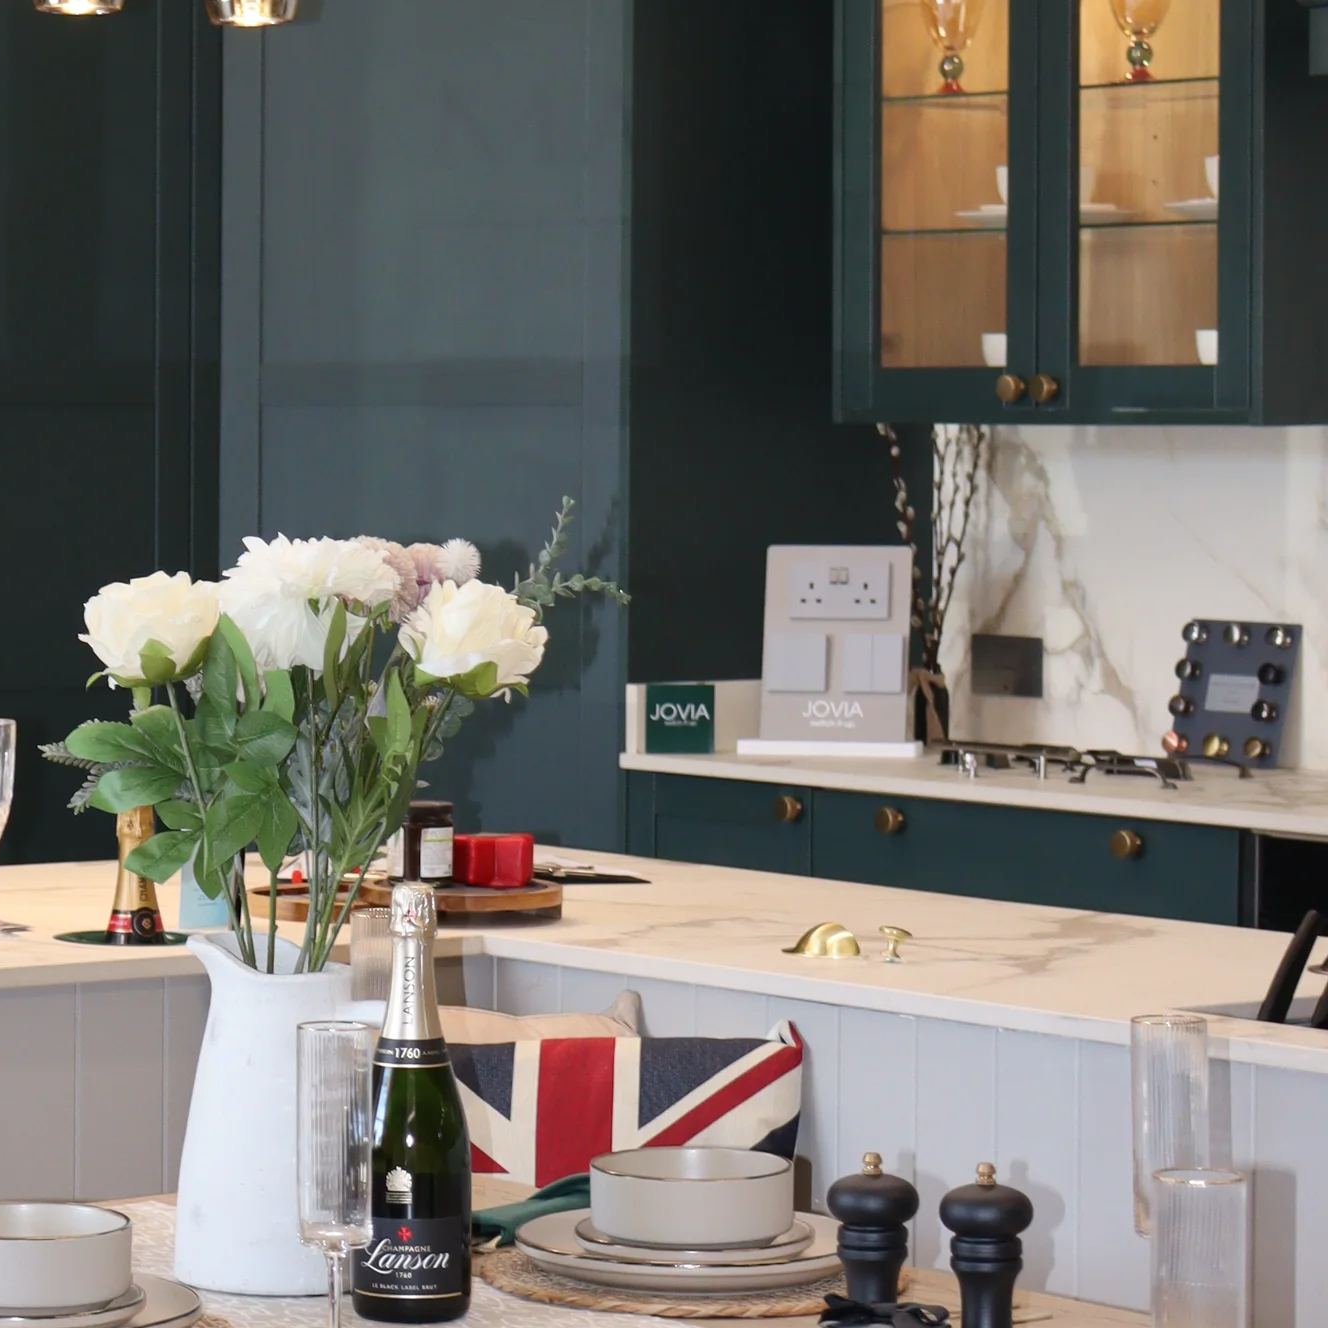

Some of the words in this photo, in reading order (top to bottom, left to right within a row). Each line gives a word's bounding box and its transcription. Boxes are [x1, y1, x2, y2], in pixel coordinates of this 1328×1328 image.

[649, 702, 711, 721] JOVIA
[802, 700, 864, 718] JOVIA
[403, 956, 415, 1025] LANSON
[394, 1047, 421, 1059] 1760
[360, 1238, 450, 1274] Lanson
[382, 1245, 432, 1253] CHAMPAGNE
